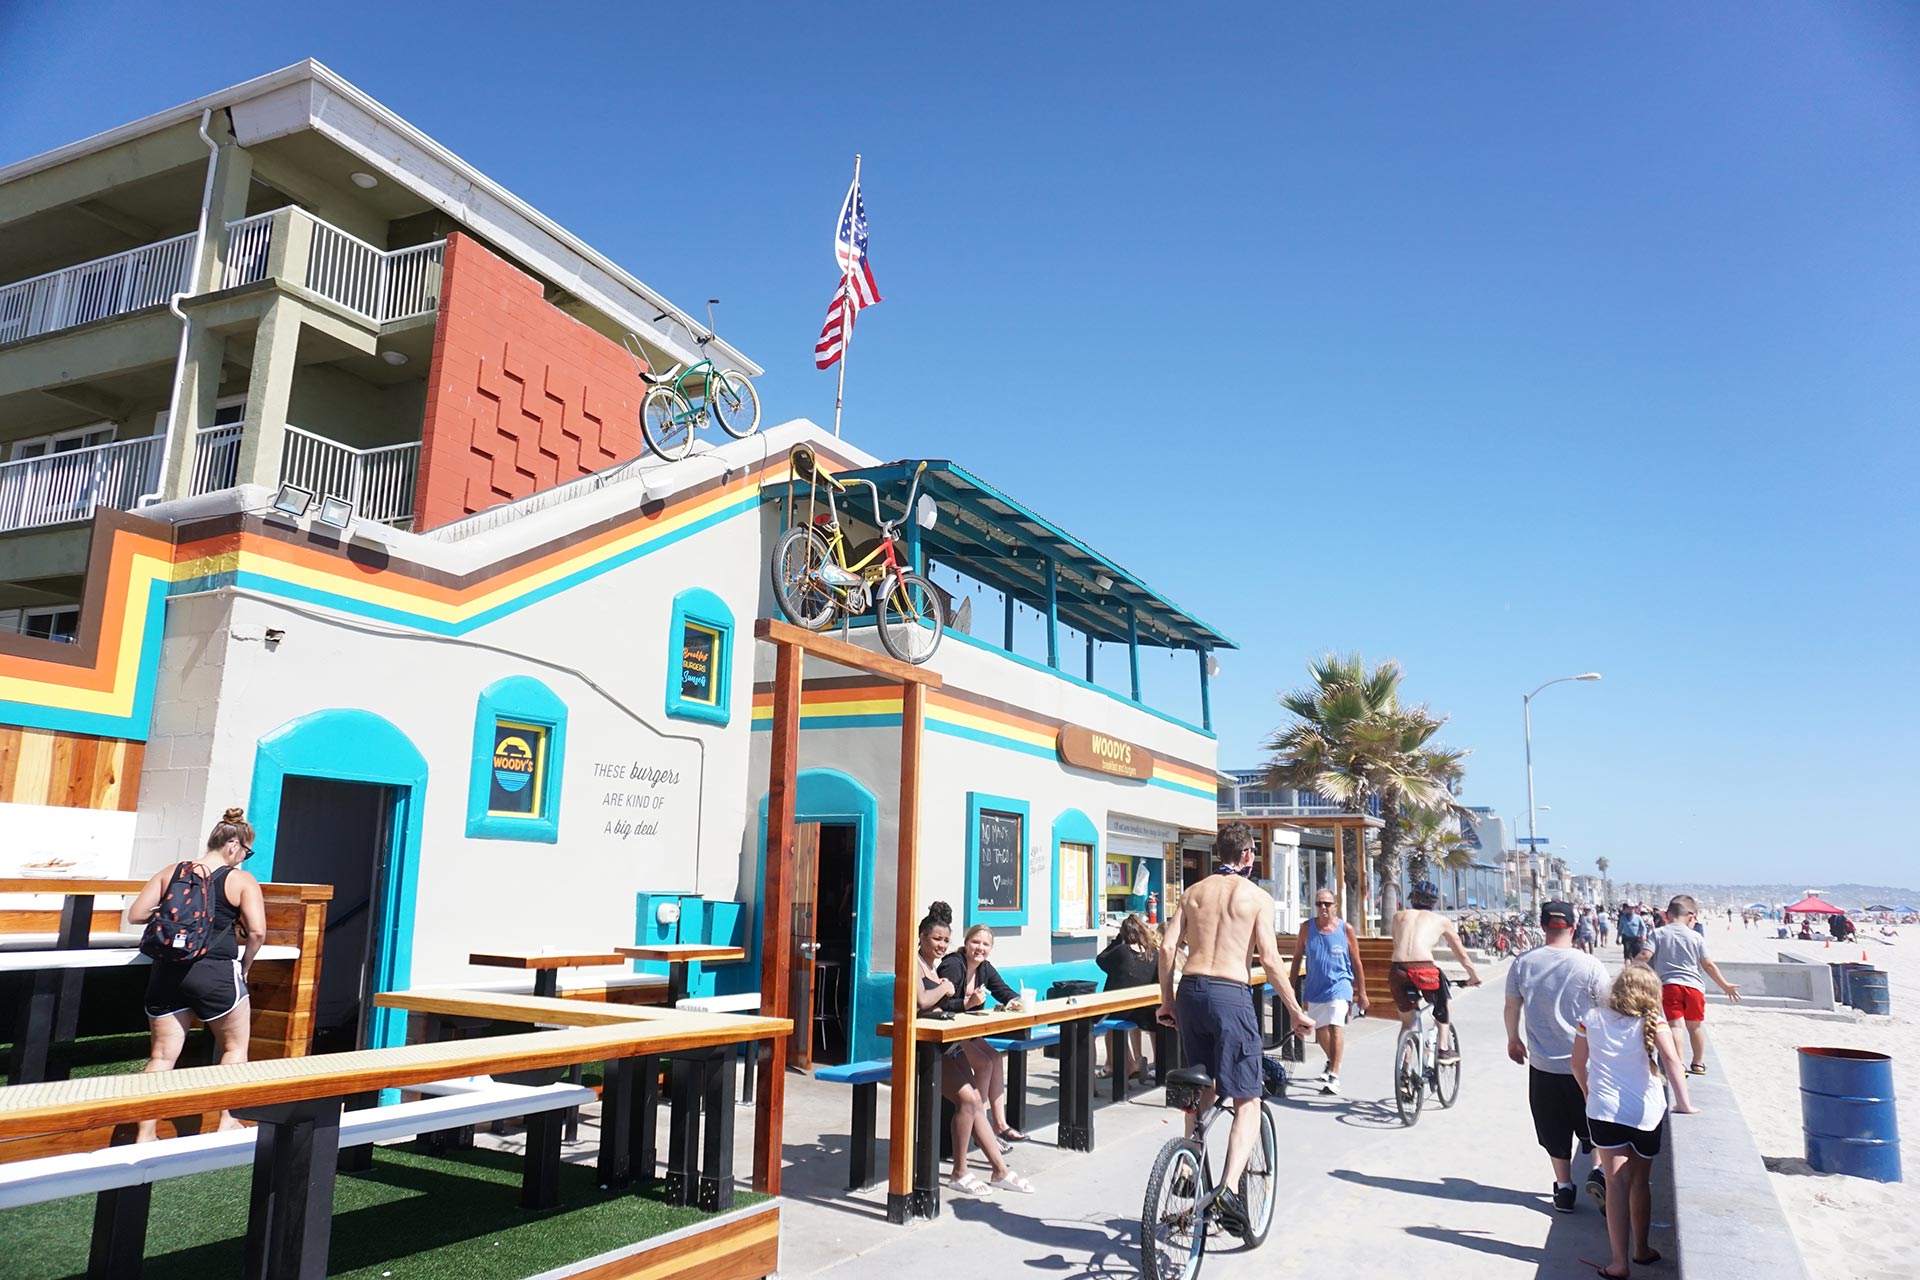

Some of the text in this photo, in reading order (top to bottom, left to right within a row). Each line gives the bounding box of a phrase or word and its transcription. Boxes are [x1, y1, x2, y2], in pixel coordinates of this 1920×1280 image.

[683, 660, 706, 673] BURGERS
[682, 670, 707, 687] Sunsets
[1091, 734, 1132, 765] WOODY'S
[493, 756, 534, 773] WOODY'S
[594, 761, 681, 789] THESE burgers
[602, 792, 665, 809] ARE KIND OF
[603, 819, 659, 840] A big deal
